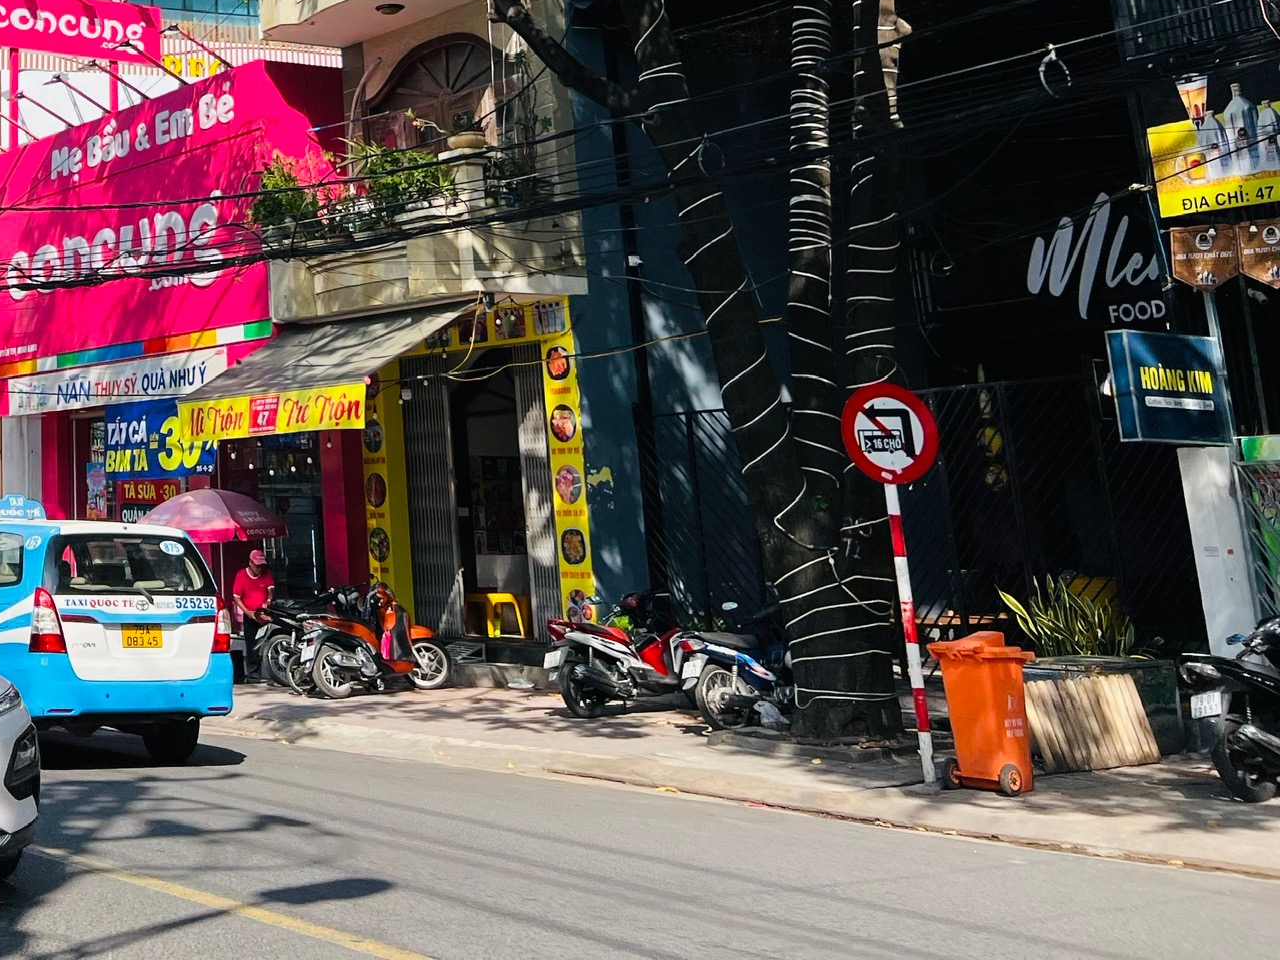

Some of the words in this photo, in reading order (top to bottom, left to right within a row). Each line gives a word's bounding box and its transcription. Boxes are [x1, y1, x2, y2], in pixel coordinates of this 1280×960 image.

[51, 146, 82, 182] Mẹ
[86, 118, 130, 167] Bầu
[134, 123, 150, 152] &
[155, 107, 194, 145] Em
[1182, 193, 1211, 213] ĐỊA
[1215, 184, 1250, 206] CHỈ:
[1255, 185, 1274, 200] 47
[6, 190, 225, 301] concung
[1108, 300, 1166, 324] FOOD
[141, 368, 167, 394] QUÀ
[169, 366, 196, 389] NHƯ
[198, 361, 207, 384] Ý
[1139, 362, 1186, 392] HOÀNG
[1186, 370, 1214, 394] KIM
[207, 404, 244, 436] Trộn
[257, 411, 269, 425] 47
[314, 393, 362, 428] Trộn
[873, 439, 883, 449] 16
[883, 435, 902, 449] CHỖ
[9, 497, 24, 506] TAXI
[163, 542, 180, 553] 875
[64, 598, 88, 607] TAXI
[89, 597, 118, 608] QUỐC
[134, 624, 151, 635] 79A
